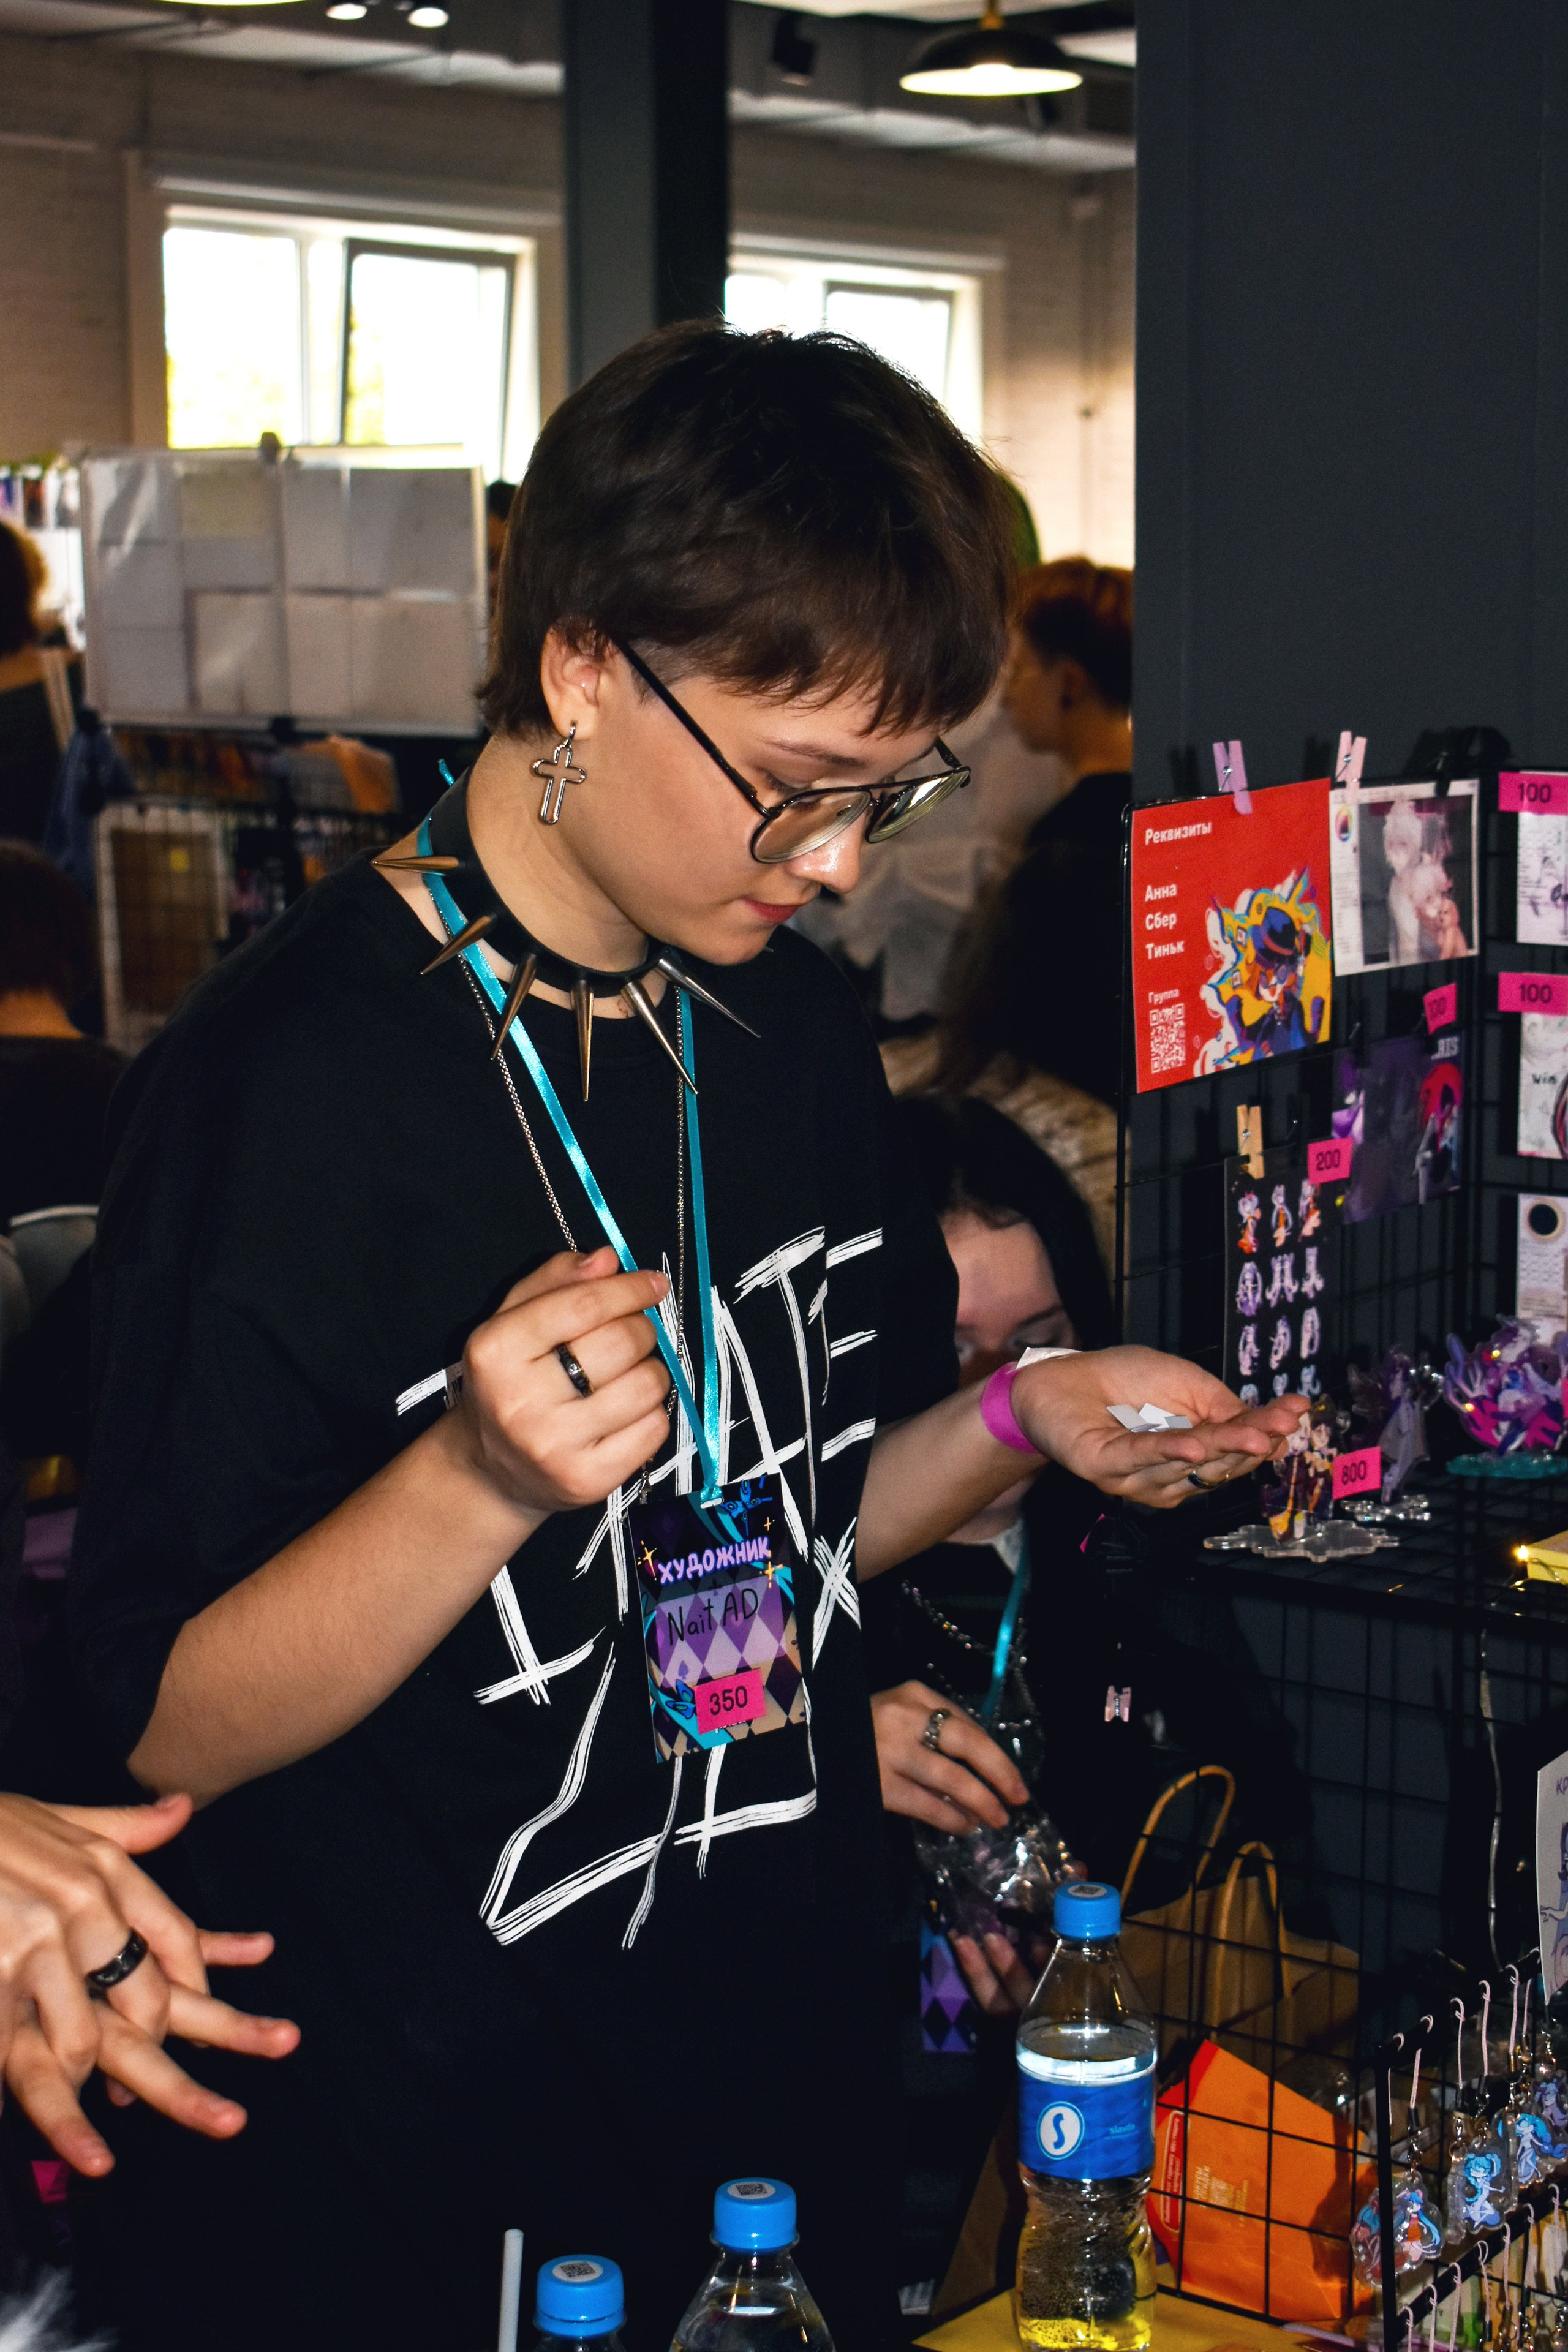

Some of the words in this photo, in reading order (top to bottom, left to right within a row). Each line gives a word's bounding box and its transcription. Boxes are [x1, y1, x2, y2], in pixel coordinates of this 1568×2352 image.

[1519, 783, 1551, 803] 100
[1145, 822, 1212, 845] Реквизиты
[1145, 884, 1177, 902] Анна
[1145, 912, 1177, 930] Сбер
[1146, 940, 1184, 960] Тиньк
[1148, 988, 1179, 1005] Группа
[1520, 984, 1552, 1003] 100
[1316, 1149, 1341, 1171] 200
[1341, 1460, 1367, 1485] 800
[657, 1536, 771, 1585] ХУДОЖНИК
[668, 1598, 714, 1646] Nait
[723, 1588, 759, 1626] AD
[709, 1686, 747, 1716] 350
[1053, 2113, 1065, 2150] S
